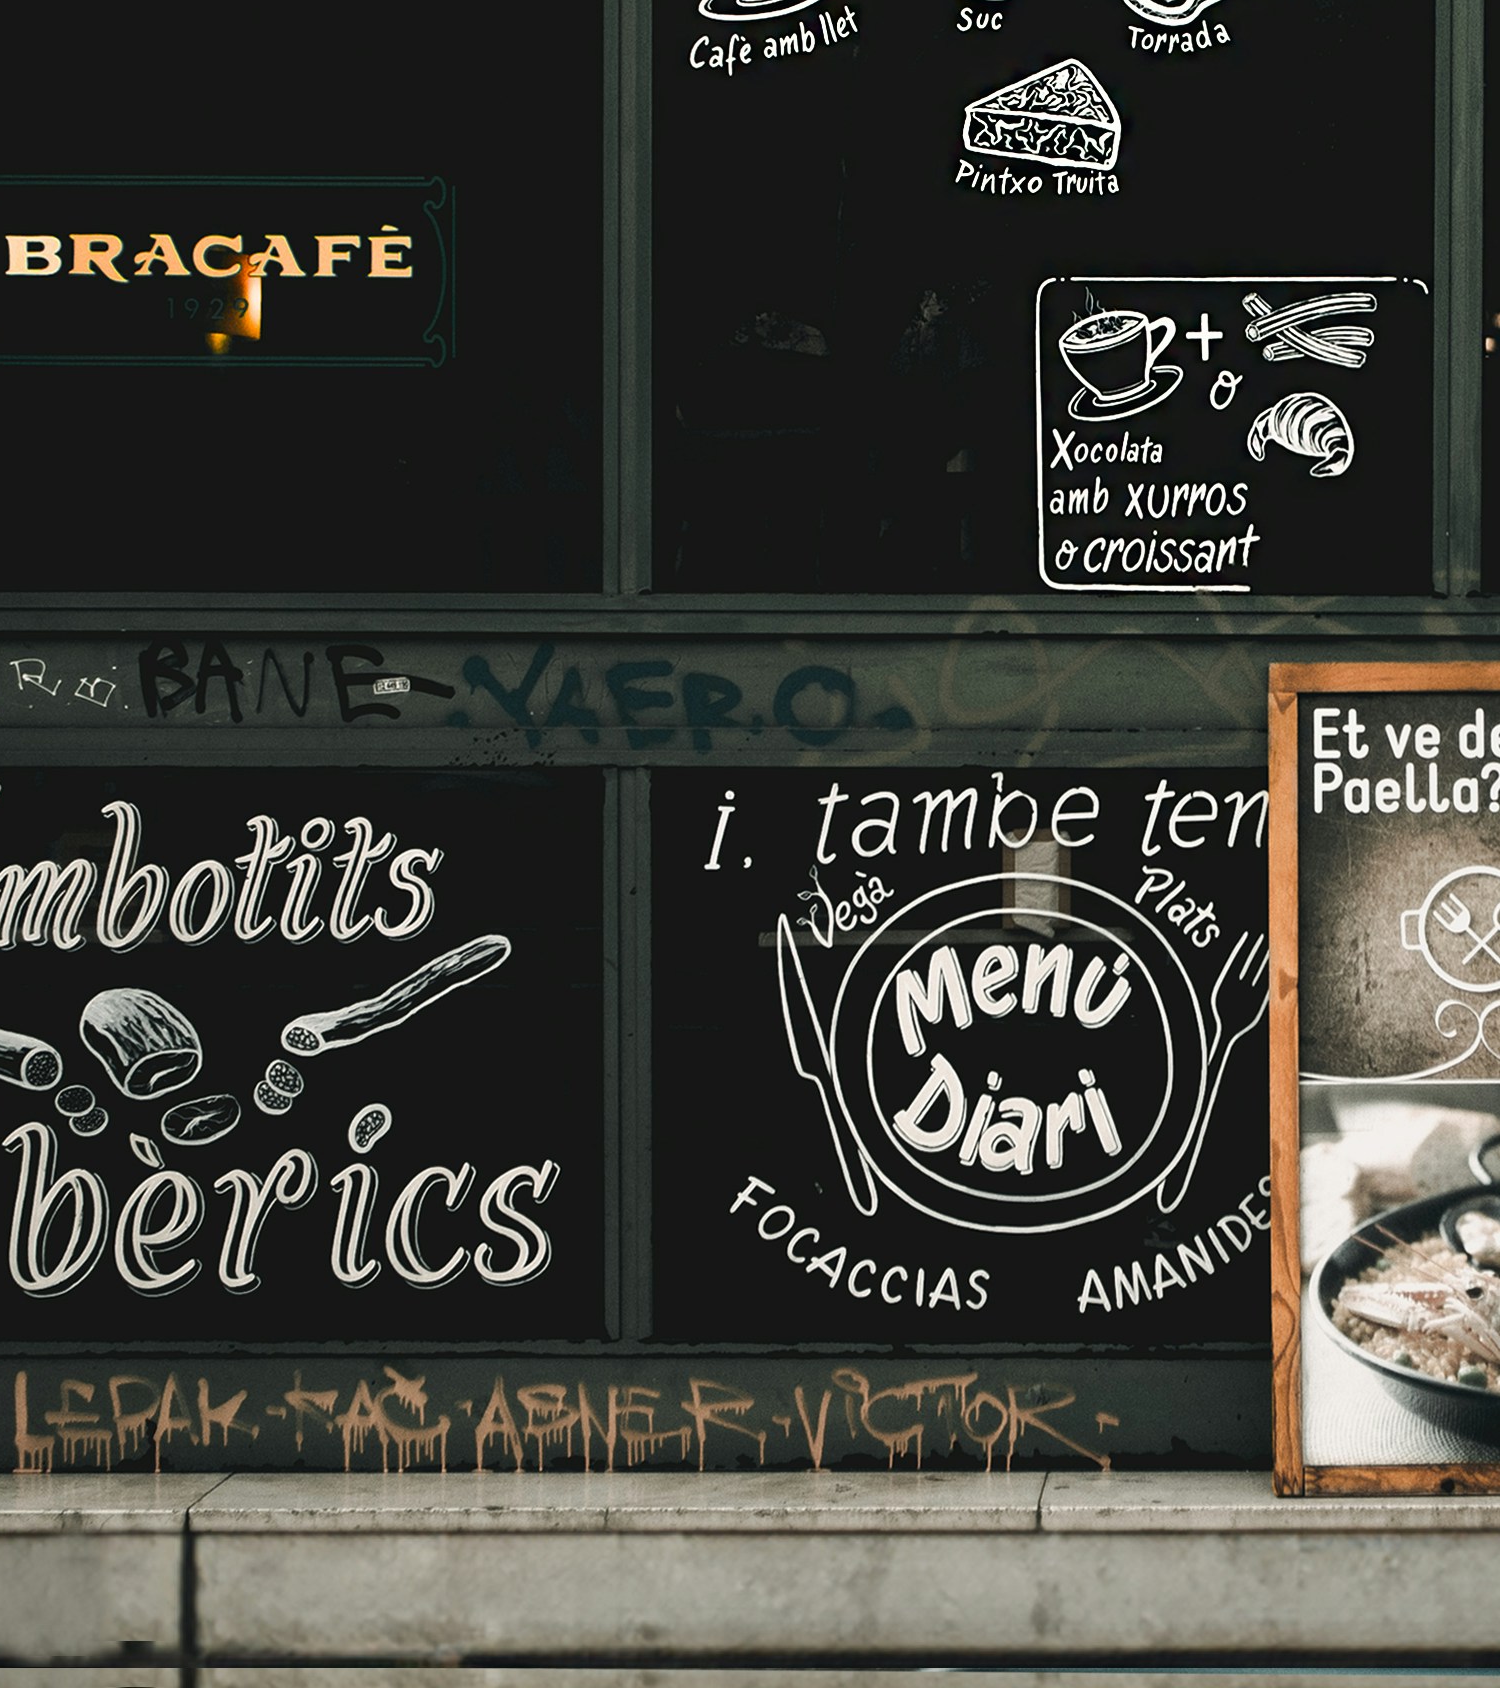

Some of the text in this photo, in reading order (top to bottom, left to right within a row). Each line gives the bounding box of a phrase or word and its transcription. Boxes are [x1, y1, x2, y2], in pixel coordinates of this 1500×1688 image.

[763, 23, 816, 59] amb
[956, 7, 1003, 32] Suc
[1127, 16, 1231, 54] Torrada
[954, 158, 1120, 196] Pintxo Truita
[1049, 428, 1163, 472] Xocolata
[1049, 476, 1109, 515] amb
[1083, 523, 1261, 574] croissant
[1313, 708, 1369, 765] Et
[1385, 724, 1441, 759] ve
[1134, 865, 1221, 949] Plats
[893, 939, 1135, 1061] Menú
[889, 1049, 1126, 1179] Diari
[729, 1171, 995, 1311] FOCACCIAS
